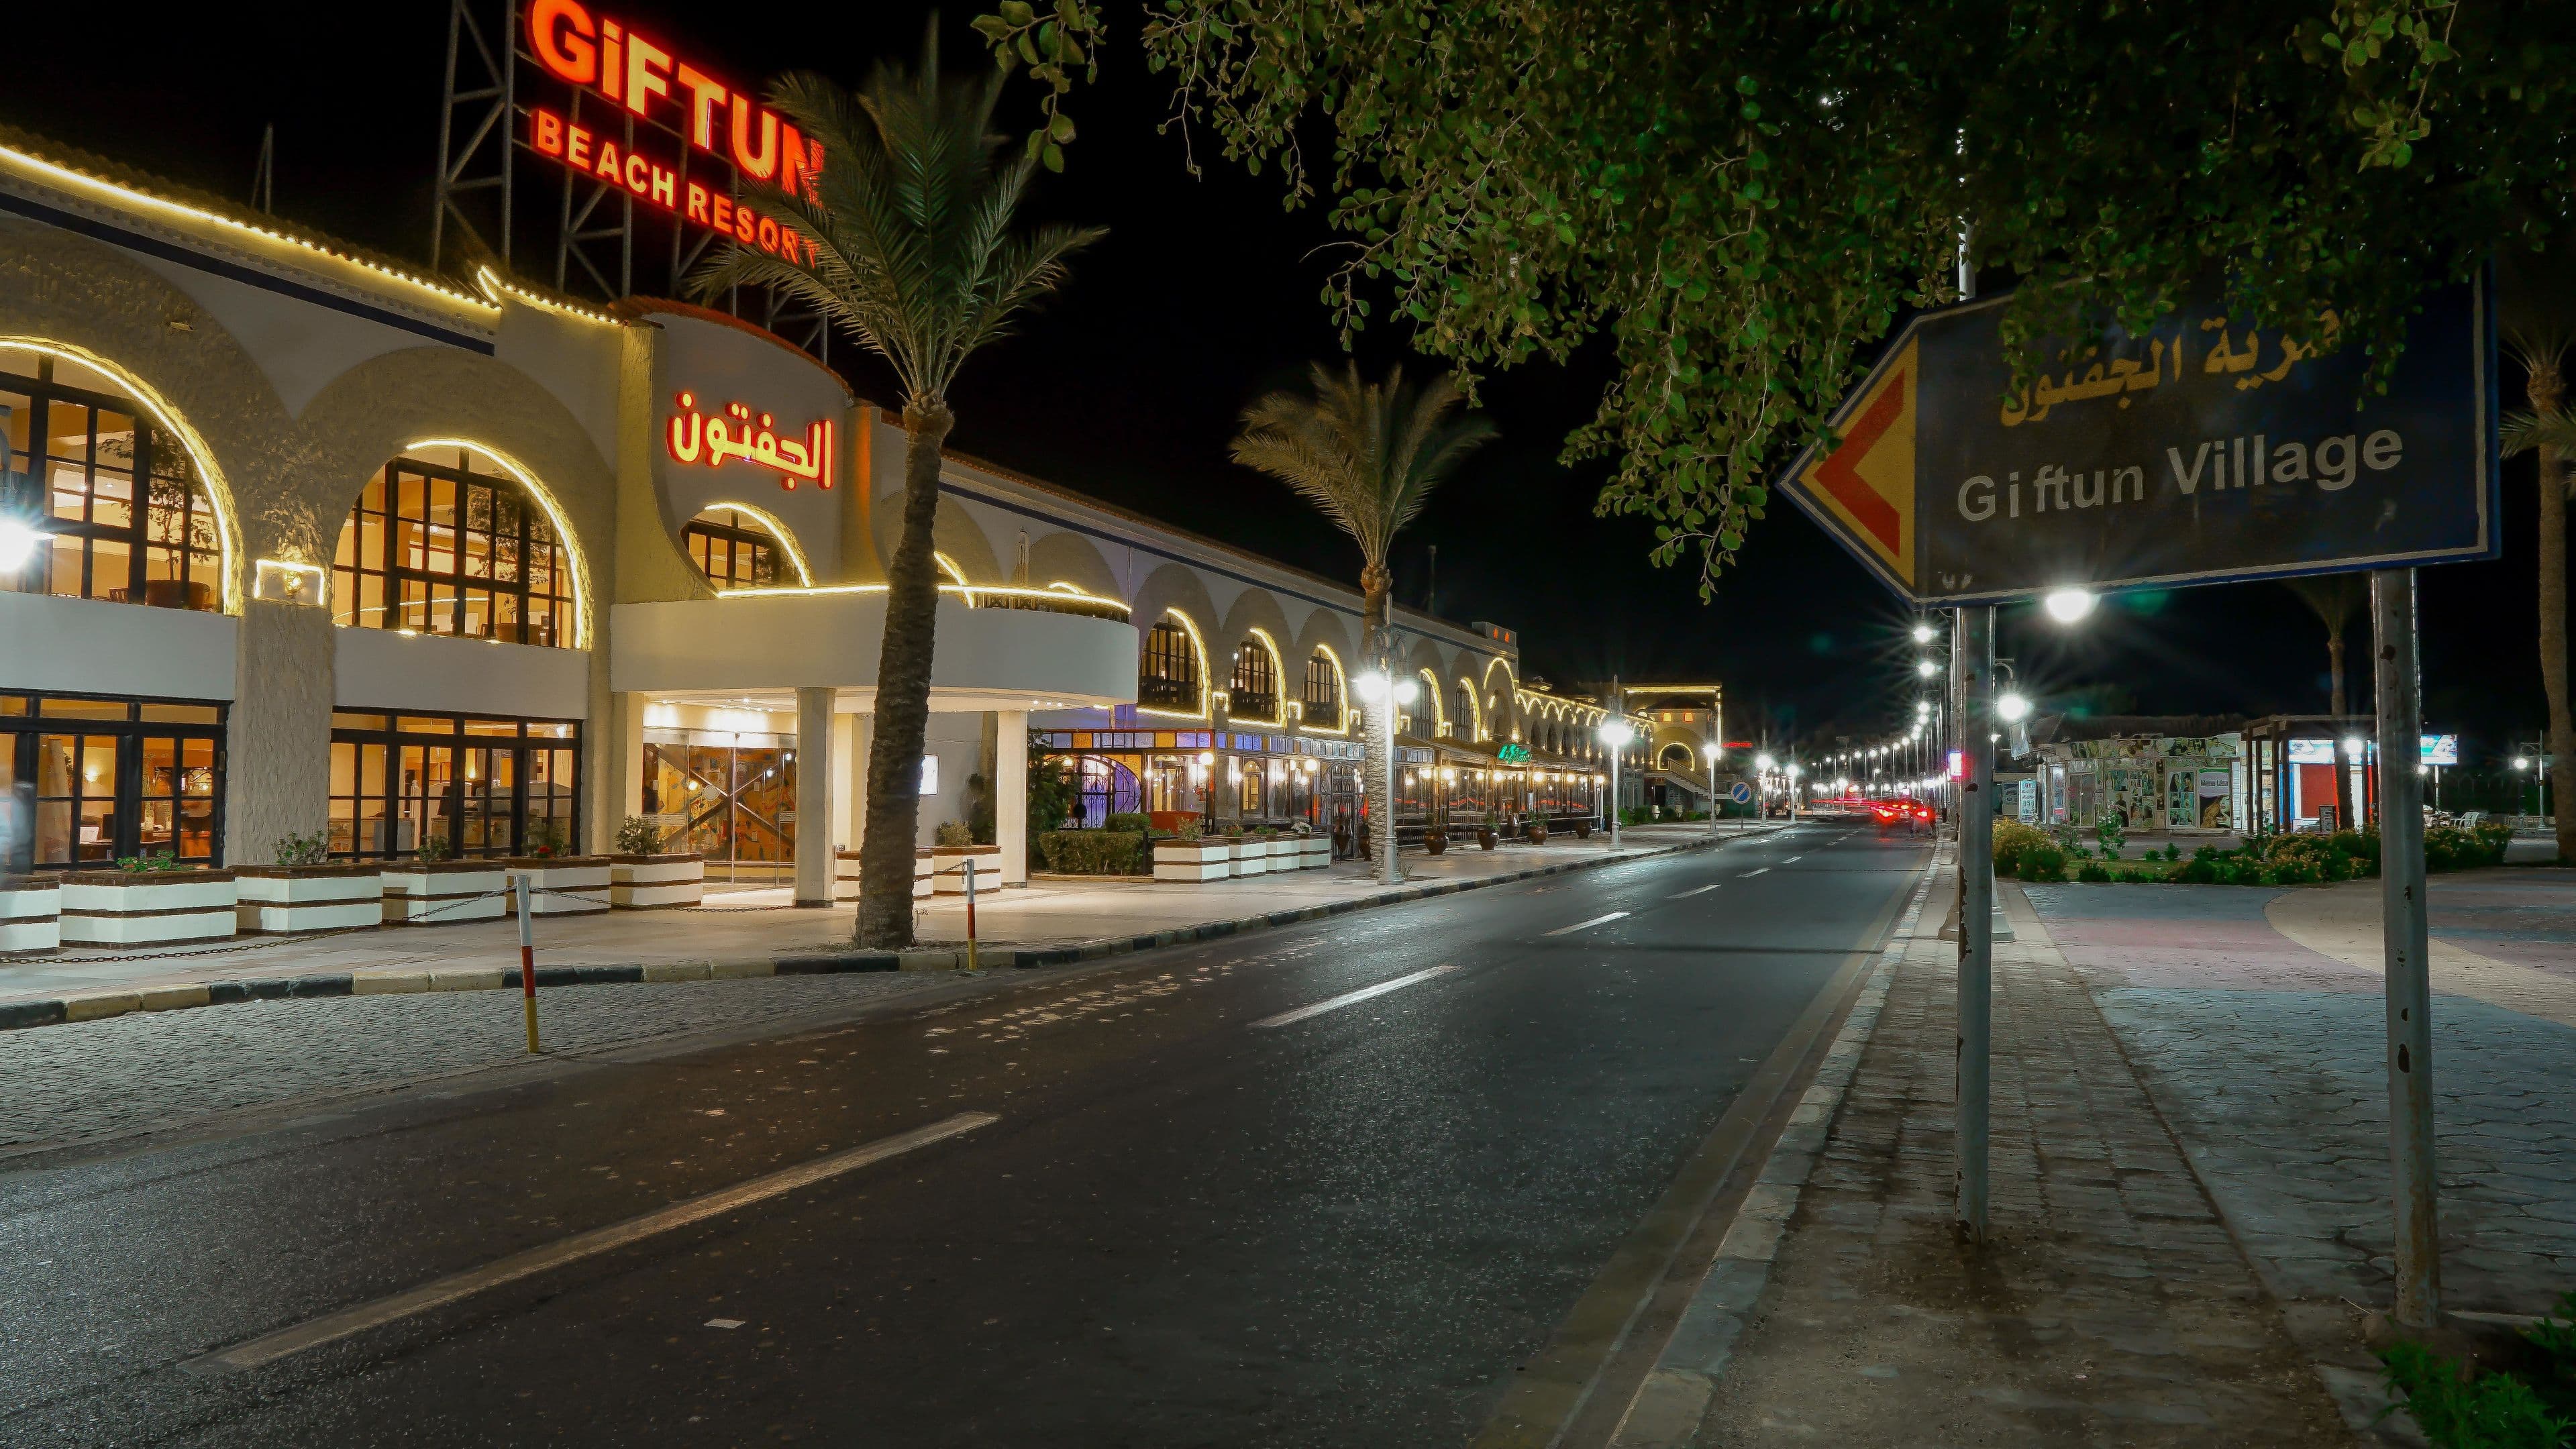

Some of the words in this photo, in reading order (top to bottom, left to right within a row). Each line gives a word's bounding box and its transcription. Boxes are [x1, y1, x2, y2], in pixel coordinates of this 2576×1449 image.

[536, 109, 675, 209] BEACH
[688, 182, 821, 268] RESORT
[667, 392, 834, 490] الجفتون
[2167, 429, 2403, 494] Village
